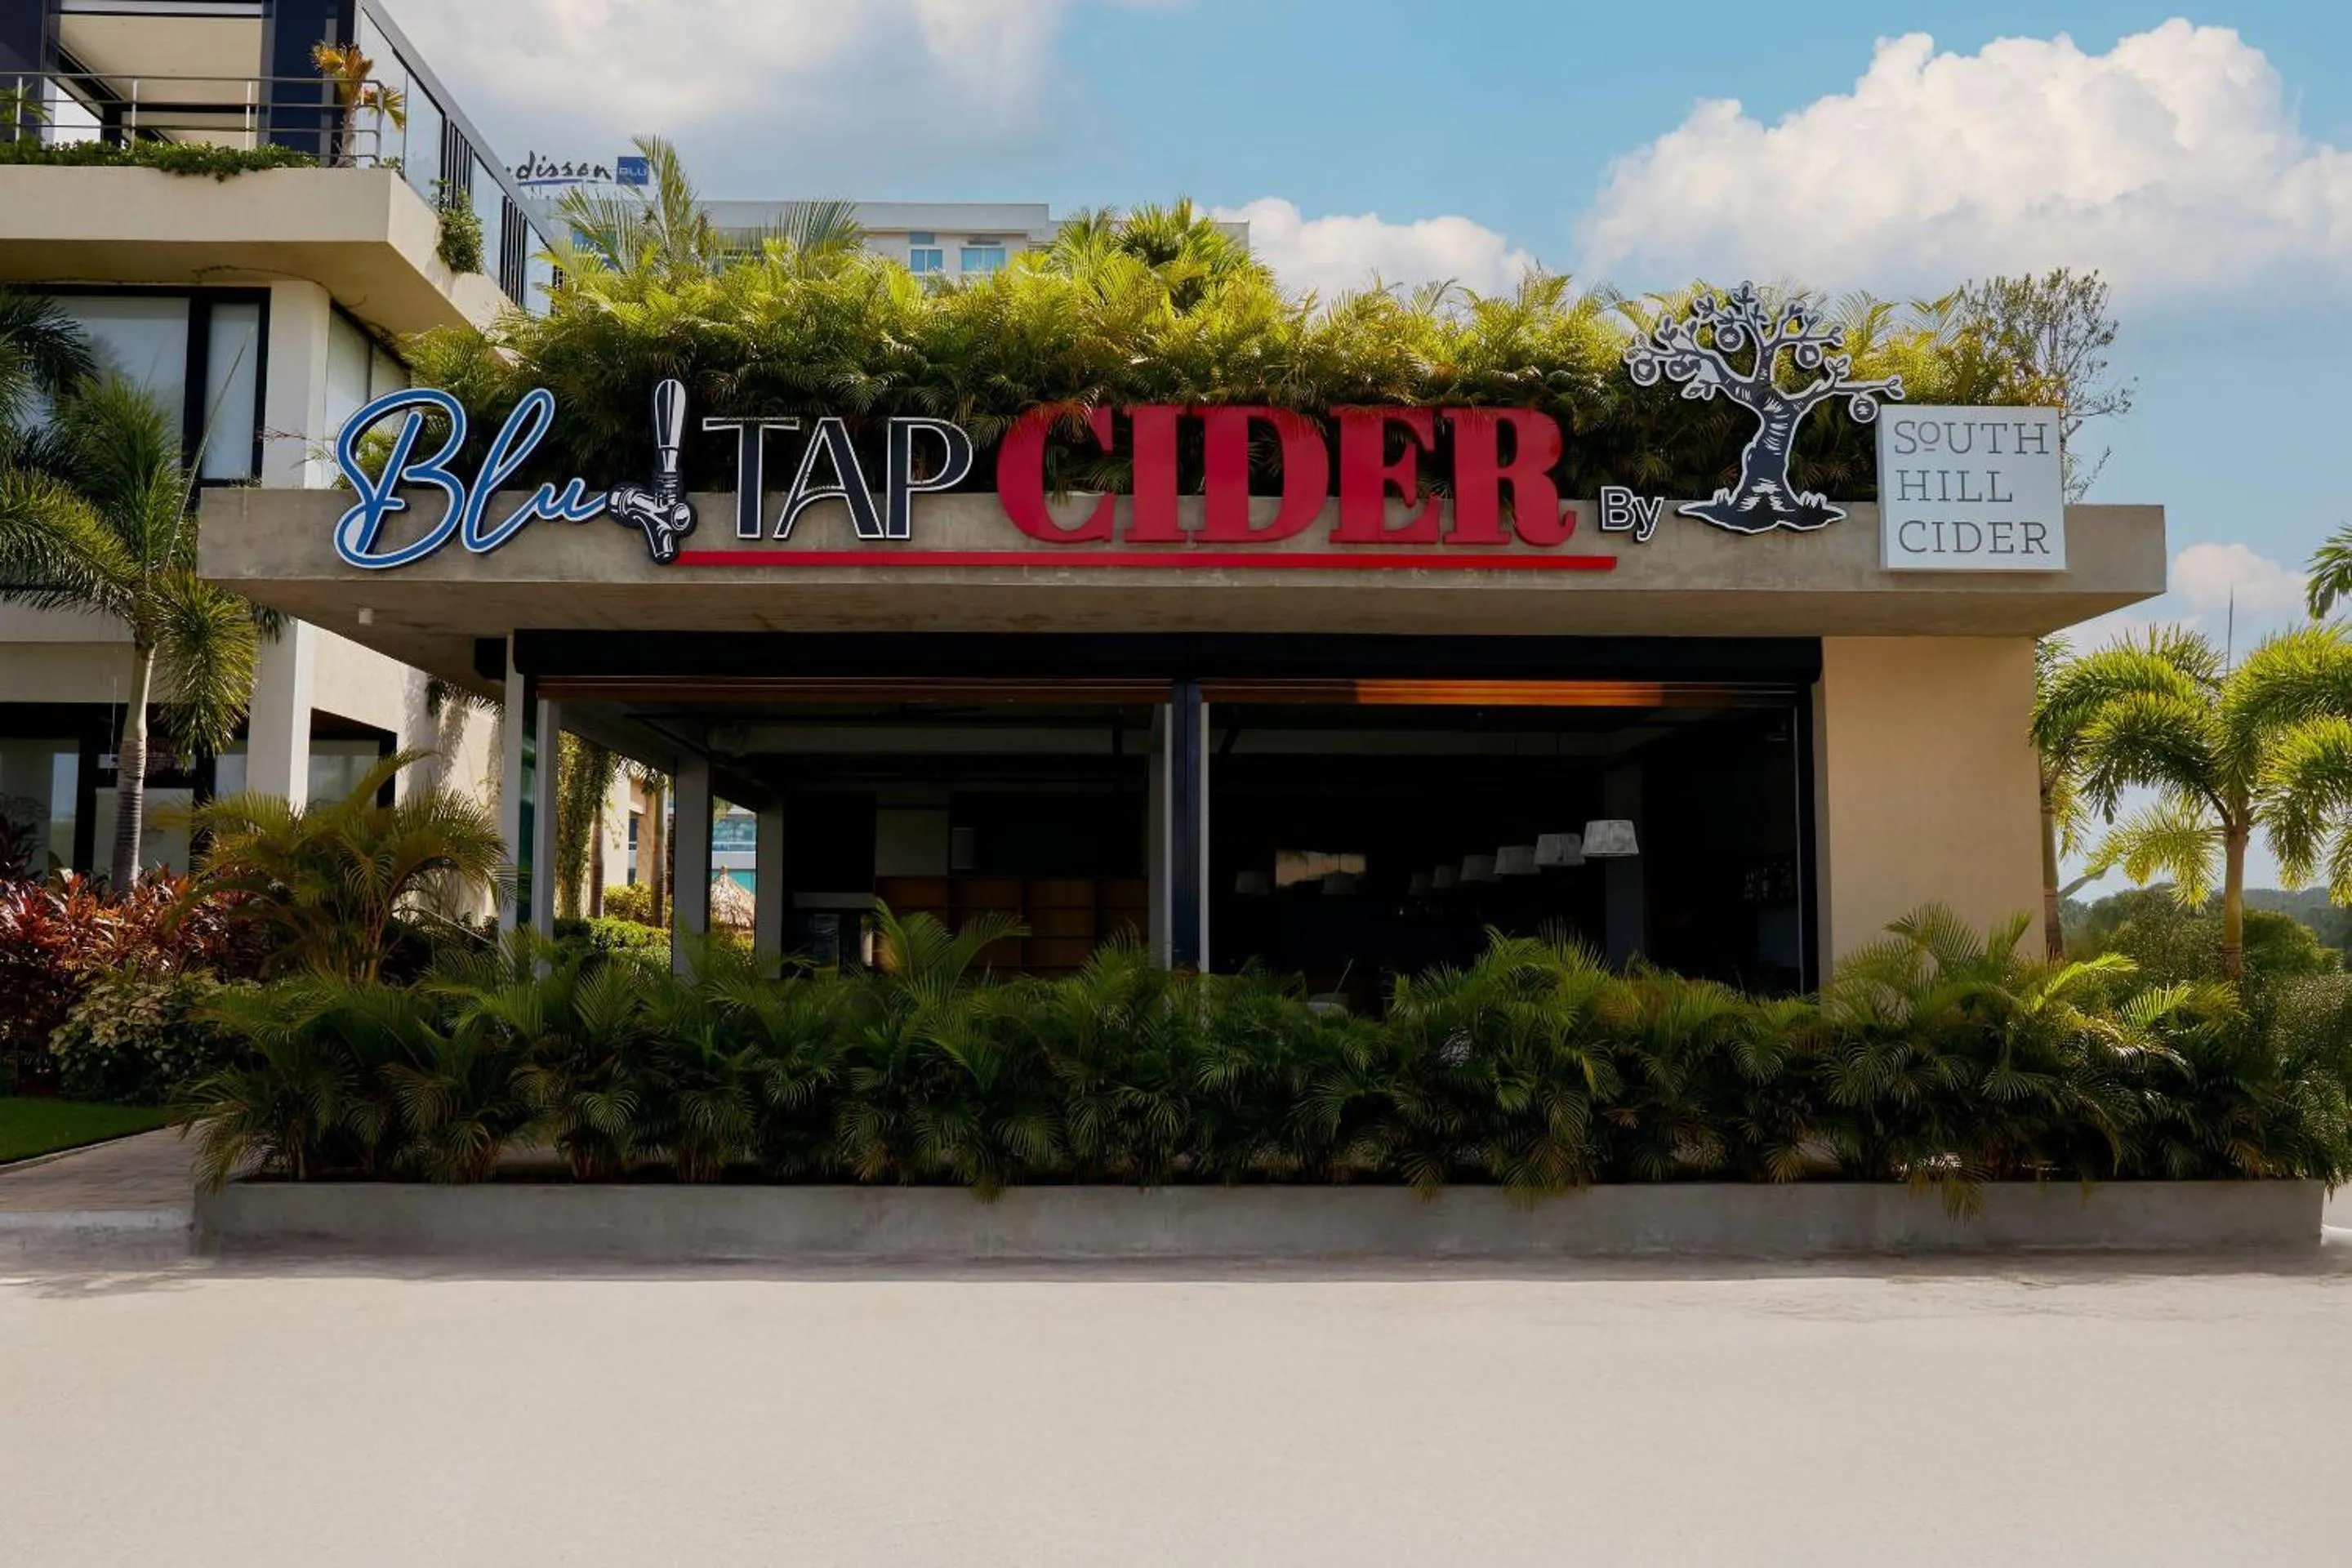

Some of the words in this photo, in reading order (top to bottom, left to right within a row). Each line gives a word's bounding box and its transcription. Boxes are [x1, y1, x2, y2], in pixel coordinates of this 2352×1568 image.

[506, 150, 612, 179] disson
[334, 387, 607, 569] Blu
[702, 416, 974, 541] TAP
[996, 404, 1577, 546] CIDER
[1601, 485, 1664, 541] By
[1895, 470, 2013, 502] HILL
[1898, 519, 2051, 554] CIDER
